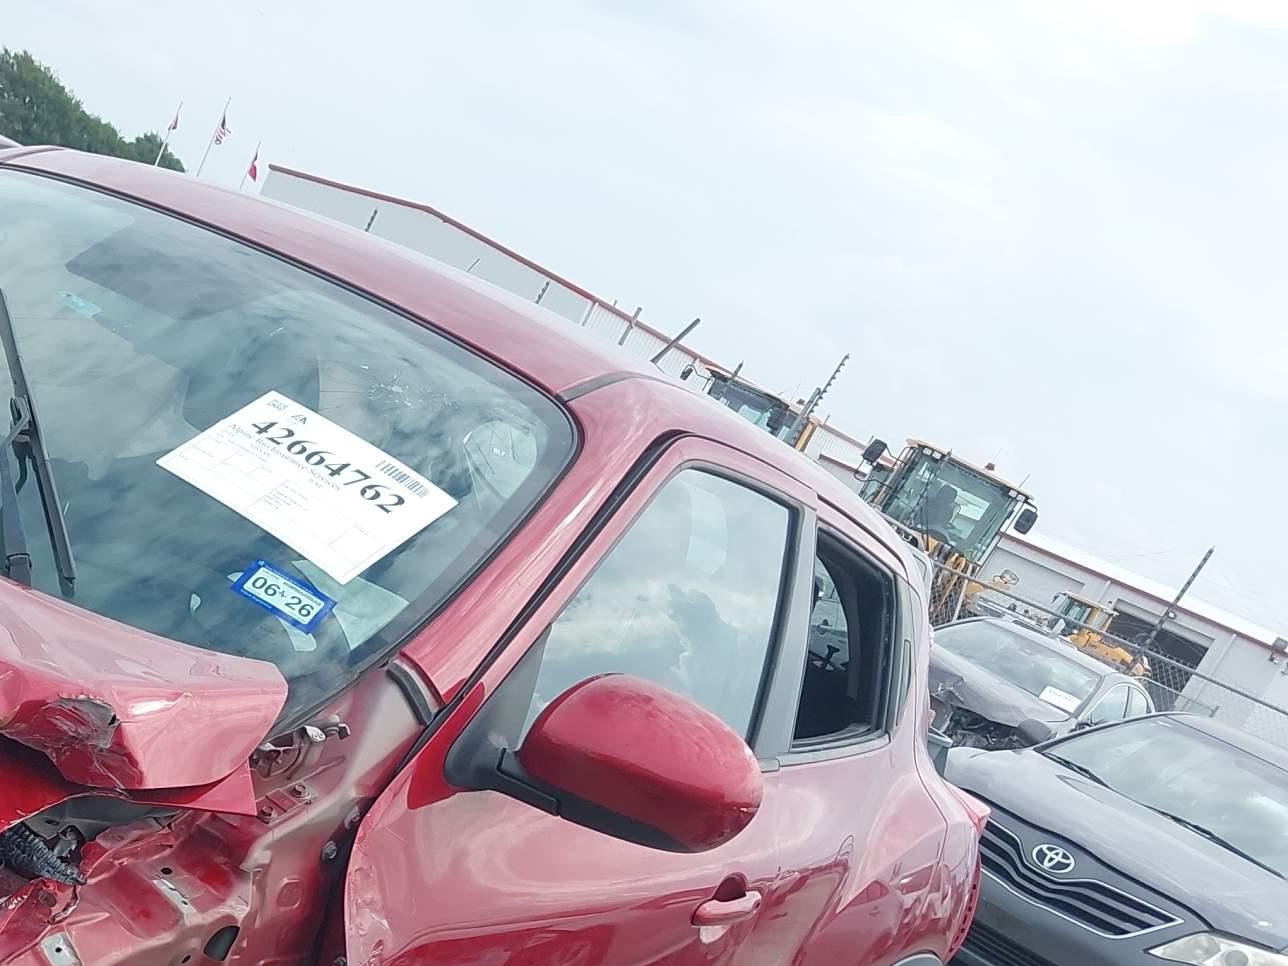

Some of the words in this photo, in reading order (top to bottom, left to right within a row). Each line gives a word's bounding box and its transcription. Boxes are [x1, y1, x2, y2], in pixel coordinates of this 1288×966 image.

[251, 421, 406, 514] 42664762
[252, 577, 280, 596] 06
[284, 596, 314, 617] 26
